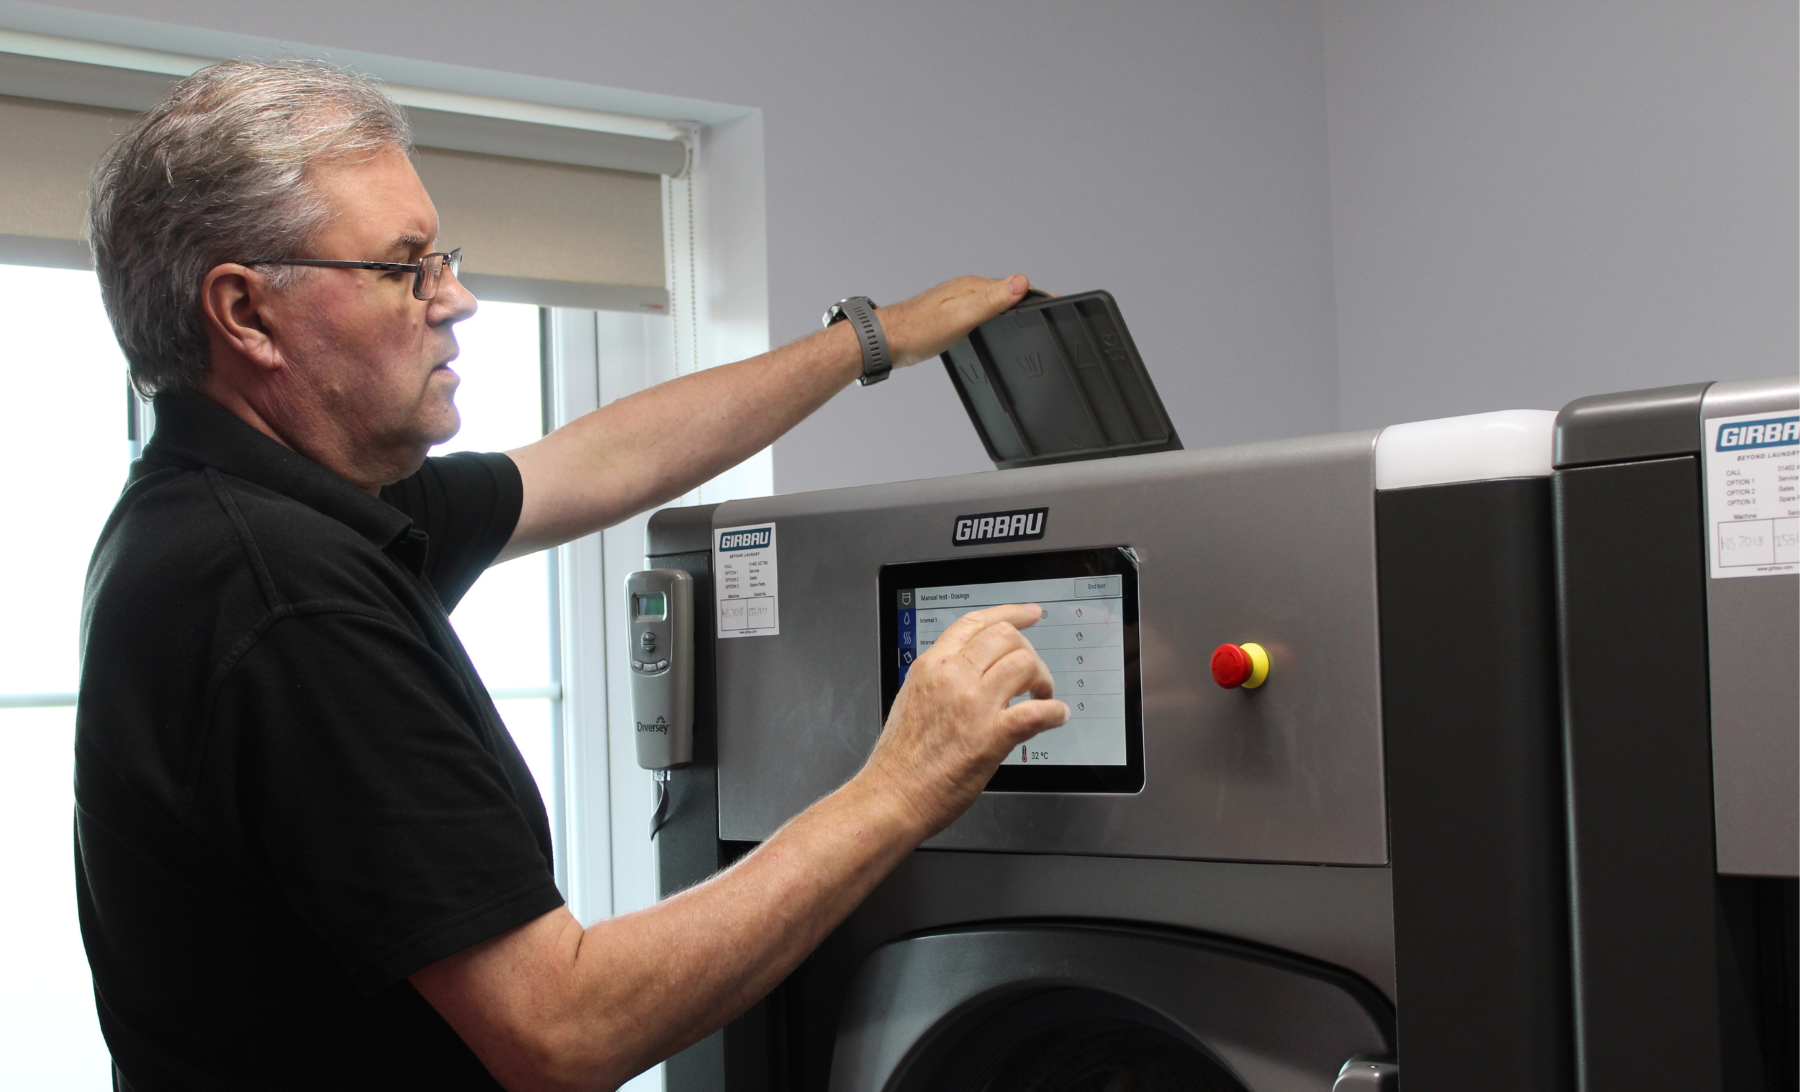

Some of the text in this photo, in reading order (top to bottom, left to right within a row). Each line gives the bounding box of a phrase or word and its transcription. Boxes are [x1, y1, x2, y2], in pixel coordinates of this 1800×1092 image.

[1768, 450, 1799, 458] LAUNDRY
[955, 512, 1044, 541] GIRBAU
[721, 531, 770, 549] GIRBAU
[637, 721, 668, 735] Diversey
[1031, 751, 1039, 759] 32
